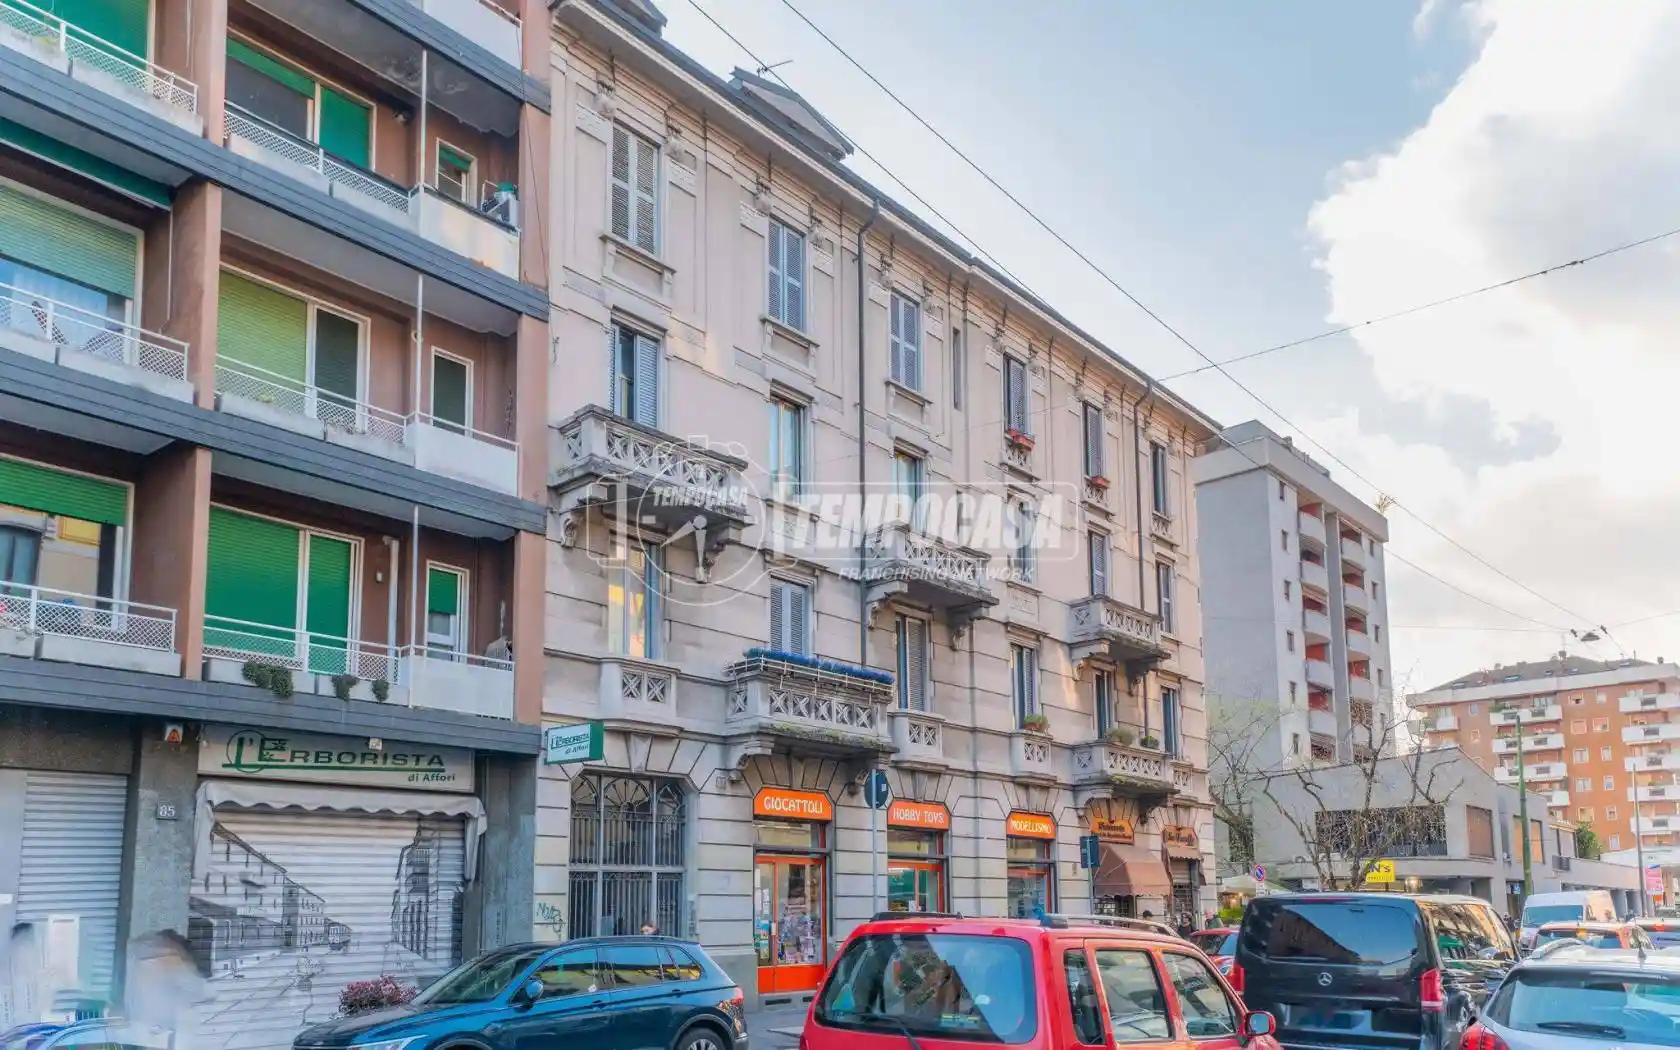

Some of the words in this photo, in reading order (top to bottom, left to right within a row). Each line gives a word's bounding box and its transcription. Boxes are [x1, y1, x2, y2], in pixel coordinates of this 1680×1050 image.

[408, 772, 420, 783] di
[422, 773, 455, 784] Affori
[763, 796, 824, 815] GIOCATTOLI
[893, 807, 921, 822] HOBBY
[1012, 820, 1052, 834] MODELLISMO
